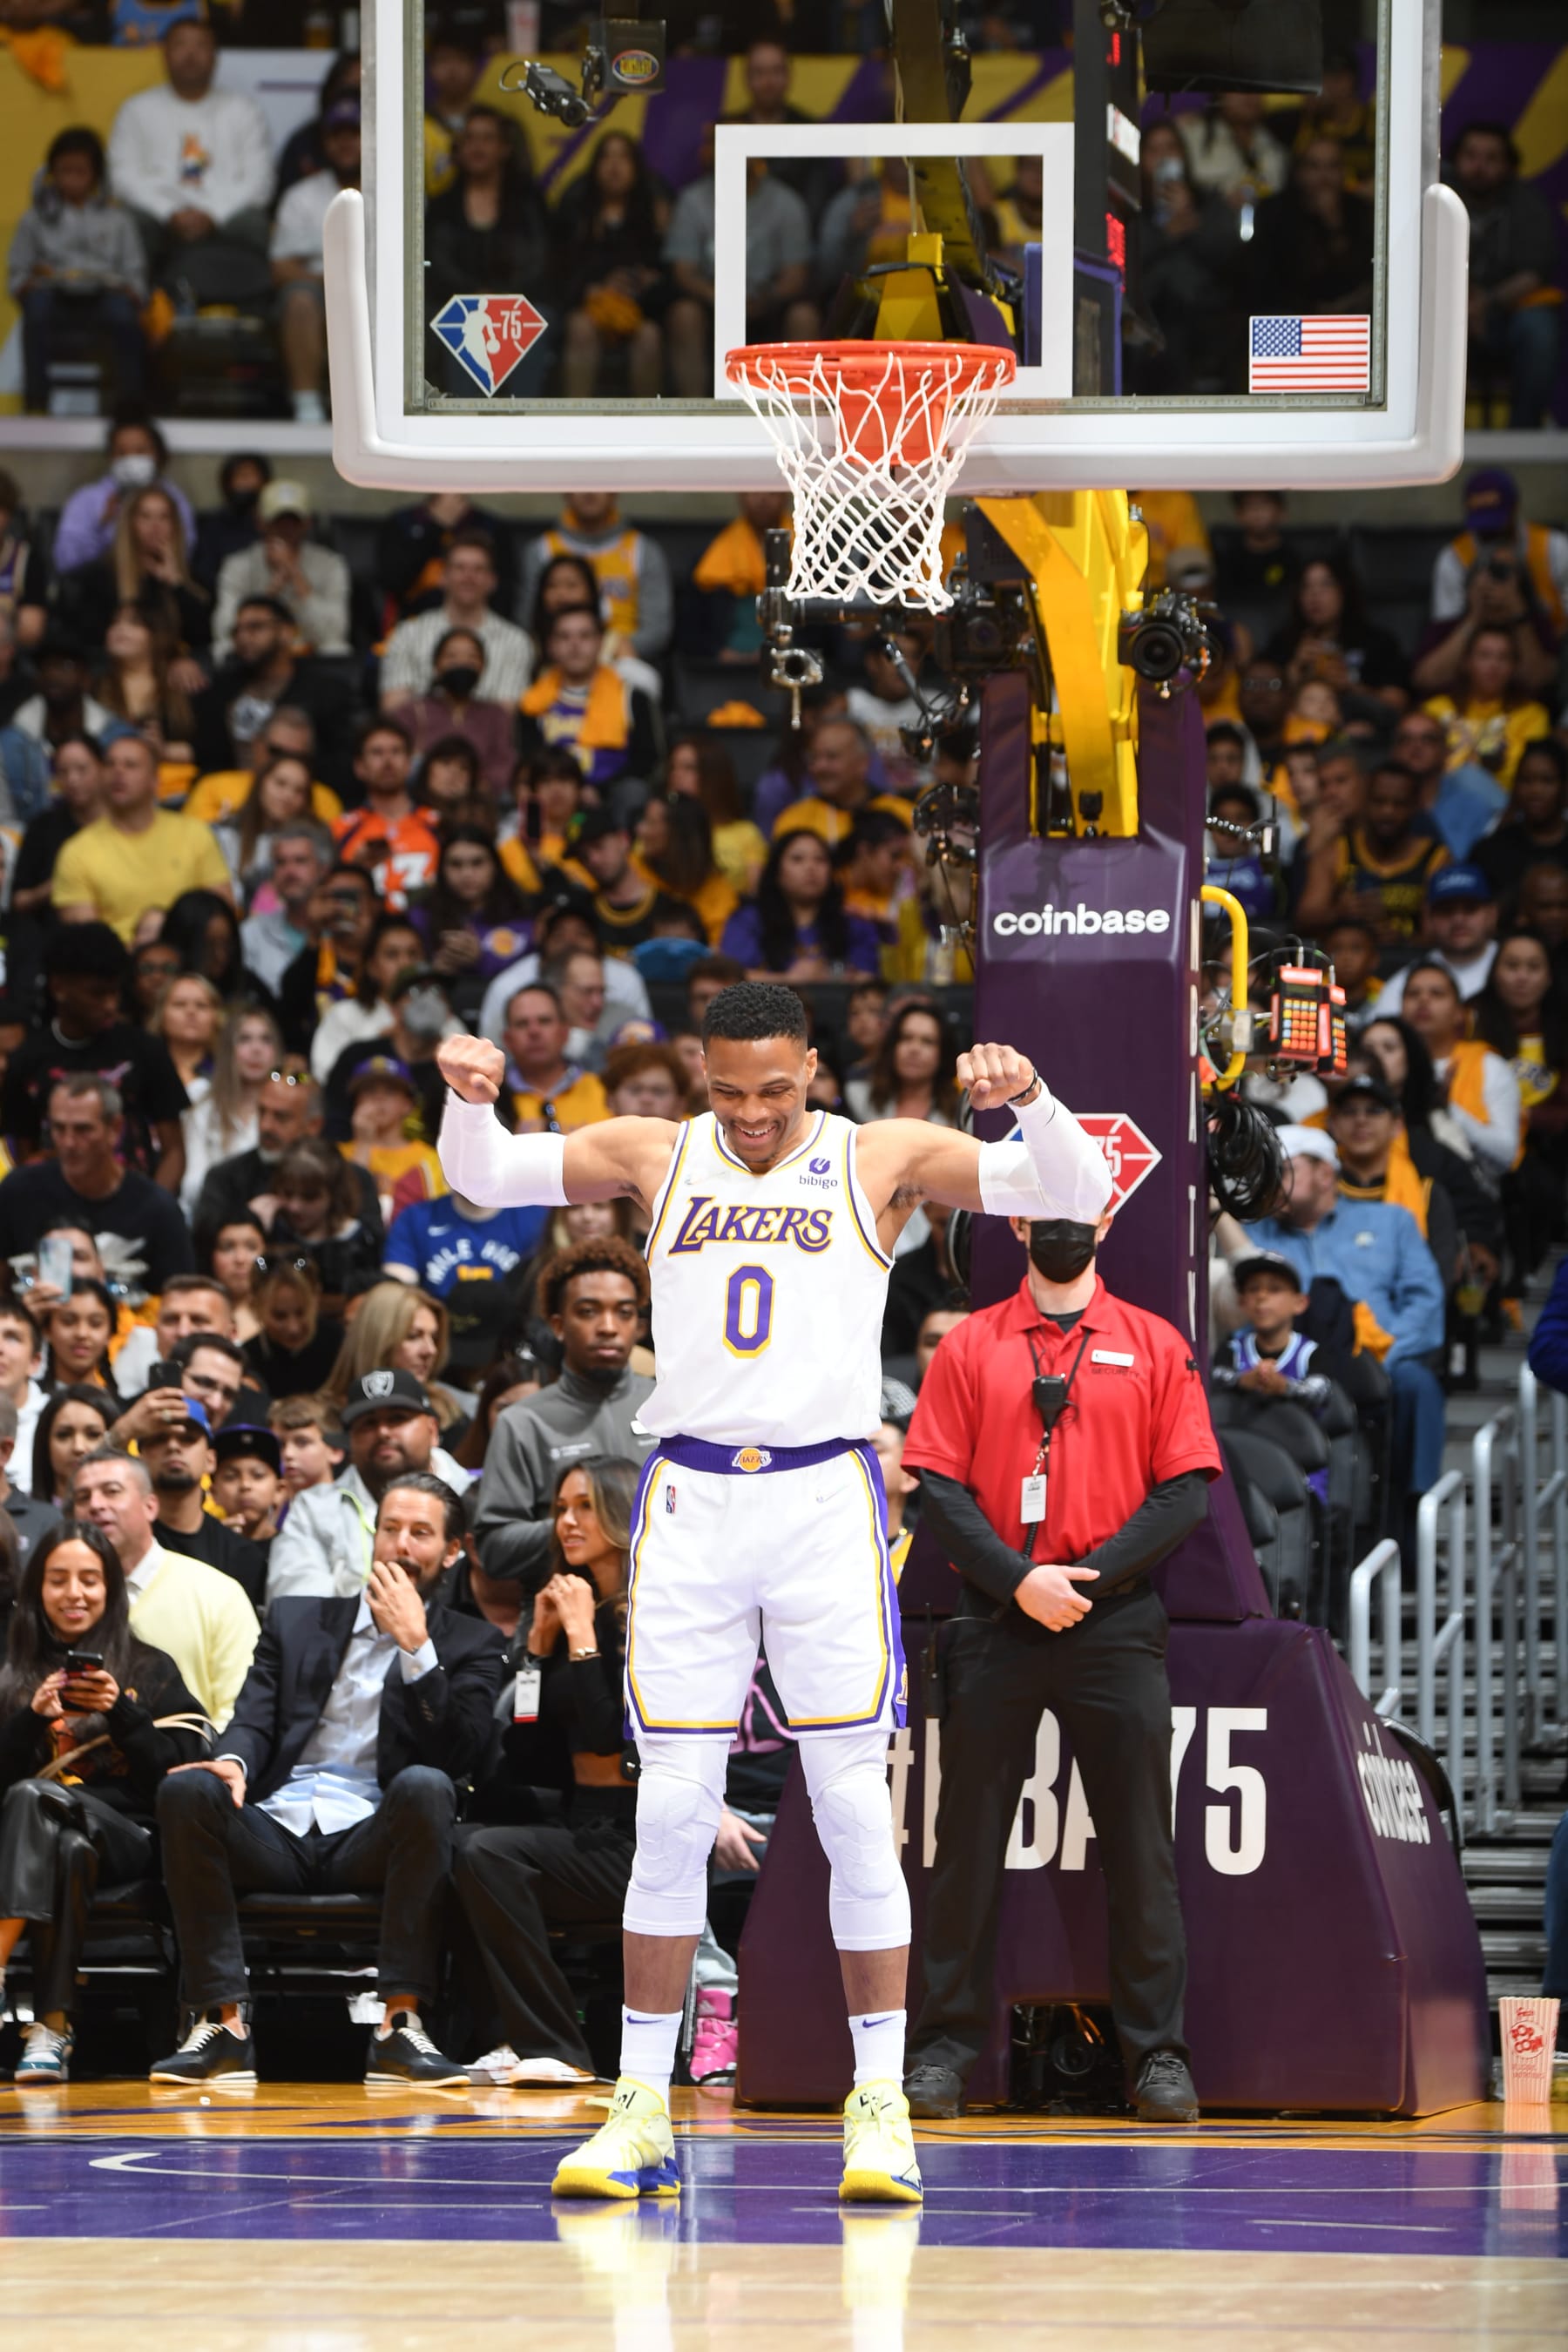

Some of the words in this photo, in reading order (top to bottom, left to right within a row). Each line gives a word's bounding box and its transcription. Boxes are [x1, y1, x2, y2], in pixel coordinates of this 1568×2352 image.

[500, 310, 522, 341] 75
[993, 902, 1170, 936] coinbase
[799, 1175, 838, 1190] bibigo
[667, 1196, 834, 1257] LAKERS
[722, 1263, 776, 1359] 0
